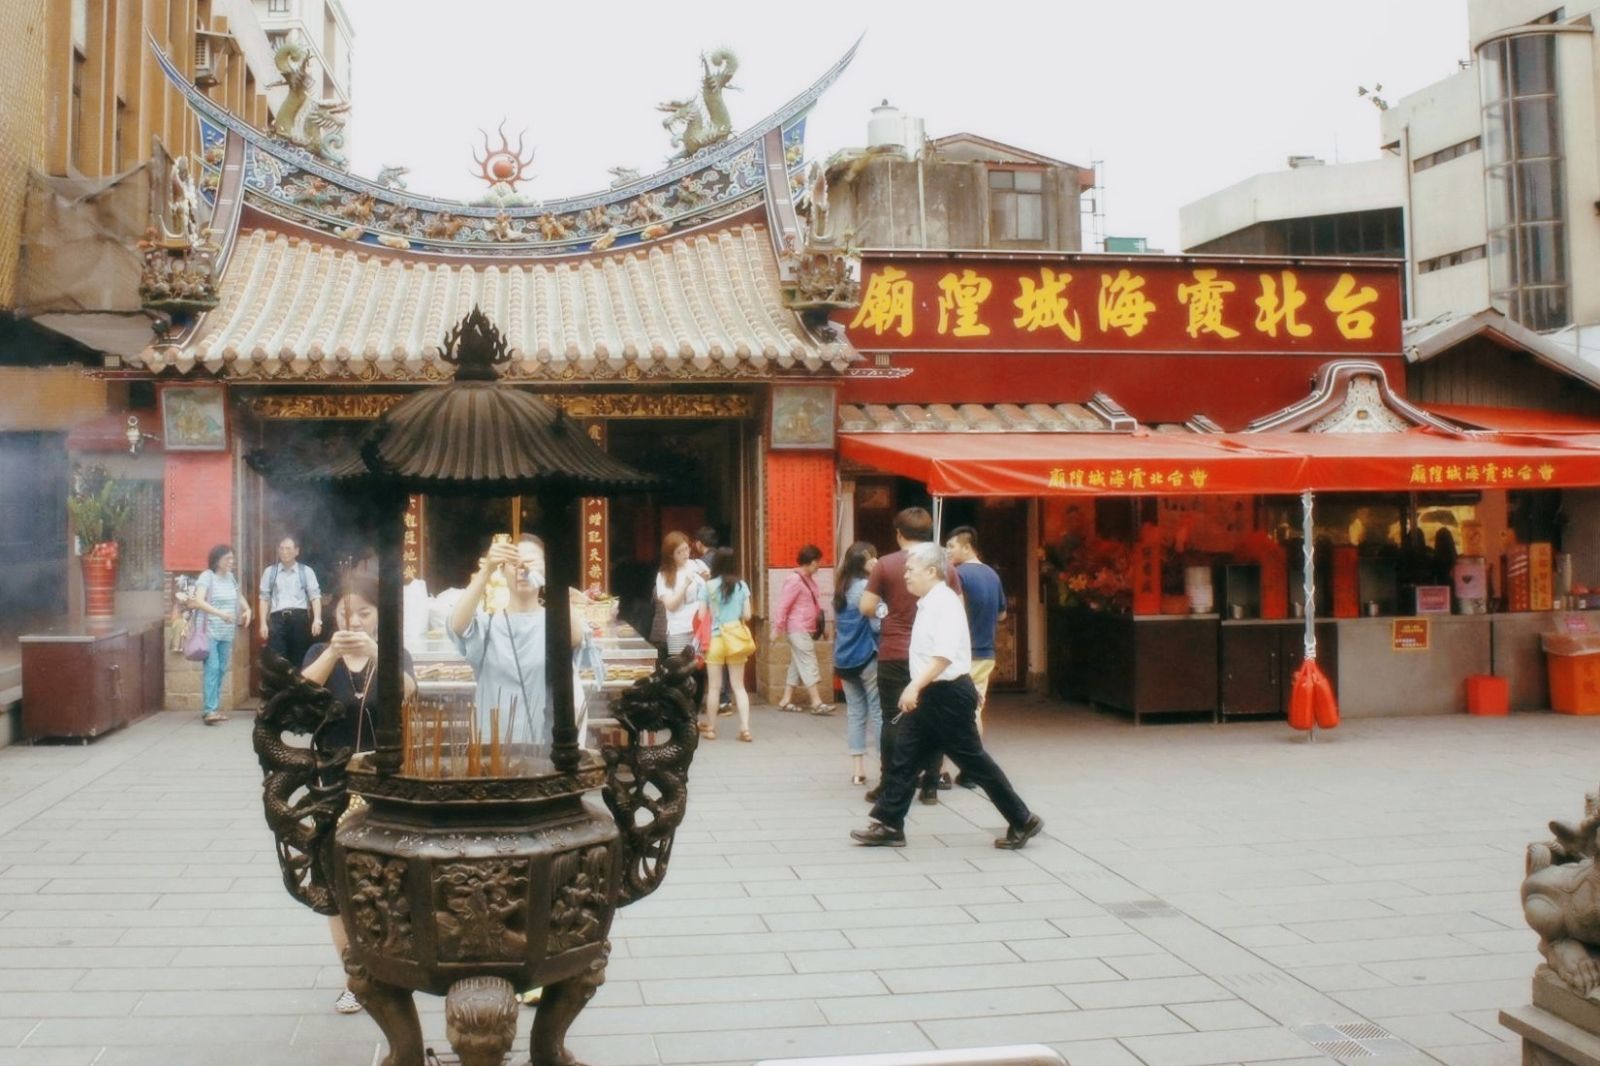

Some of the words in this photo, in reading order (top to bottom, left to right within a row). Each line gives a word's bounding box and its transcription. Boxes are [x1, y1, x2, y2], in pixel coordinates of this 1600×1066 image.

[849, 266, 1379, 342] 台北霞海城隍廟
